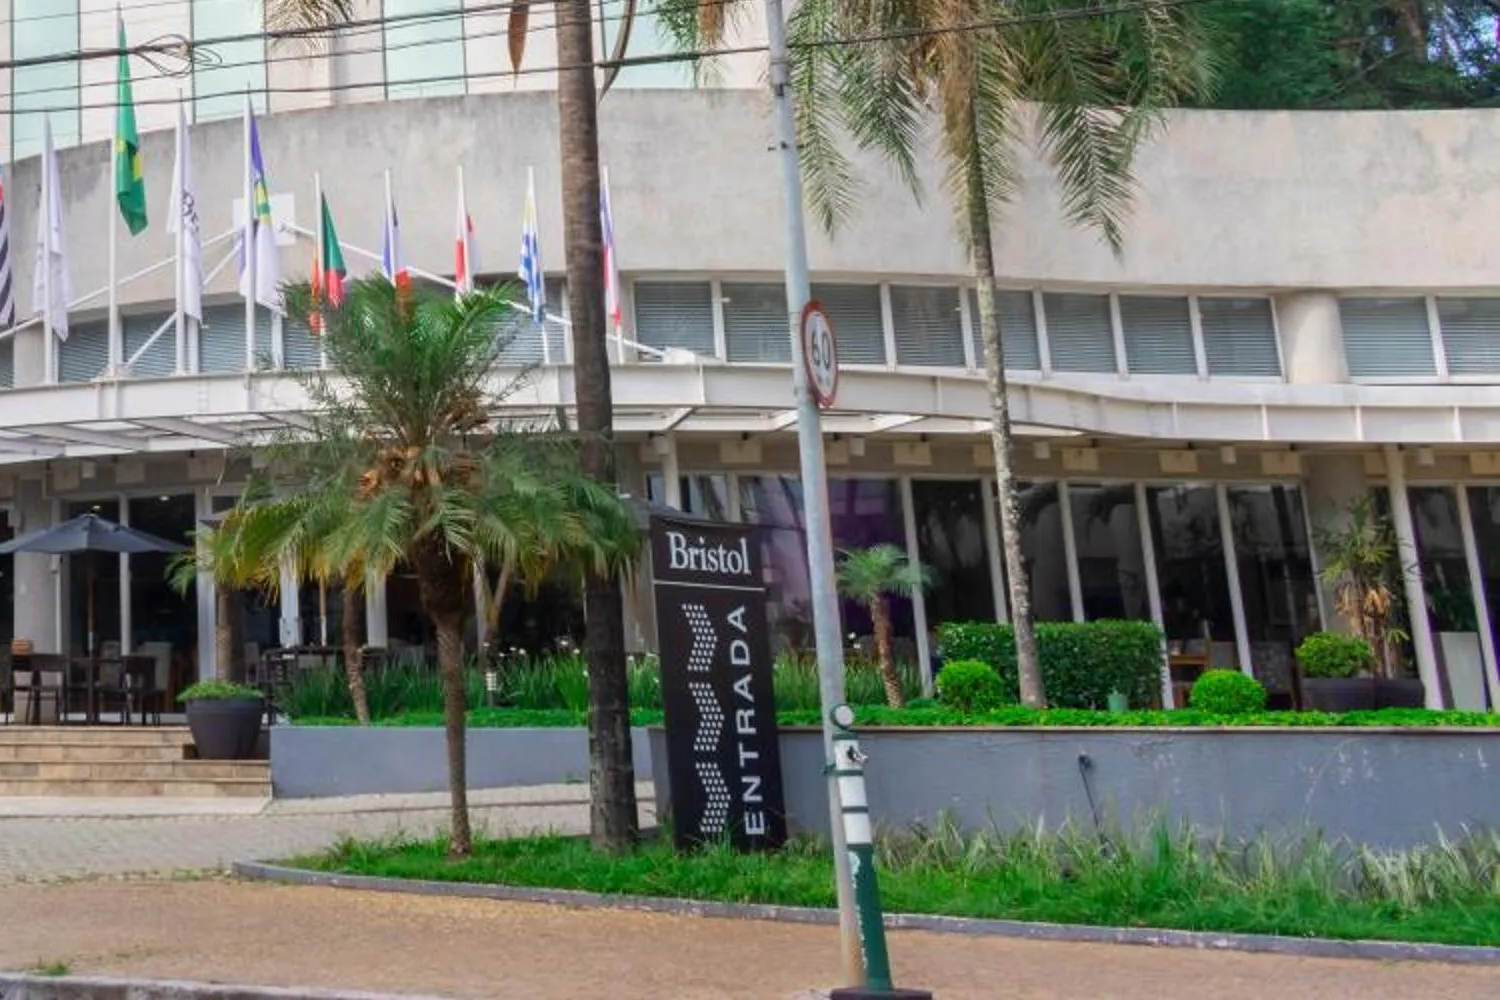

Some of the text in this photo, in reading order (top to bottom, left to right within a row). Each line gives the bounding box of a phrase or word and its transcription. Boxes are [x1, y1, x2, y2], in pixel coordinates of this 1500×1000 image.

[811, 330, 831, 371] 60
[665, 531, 752, 576] Bristol
[727, 605, 766, 836] ENTRADA
